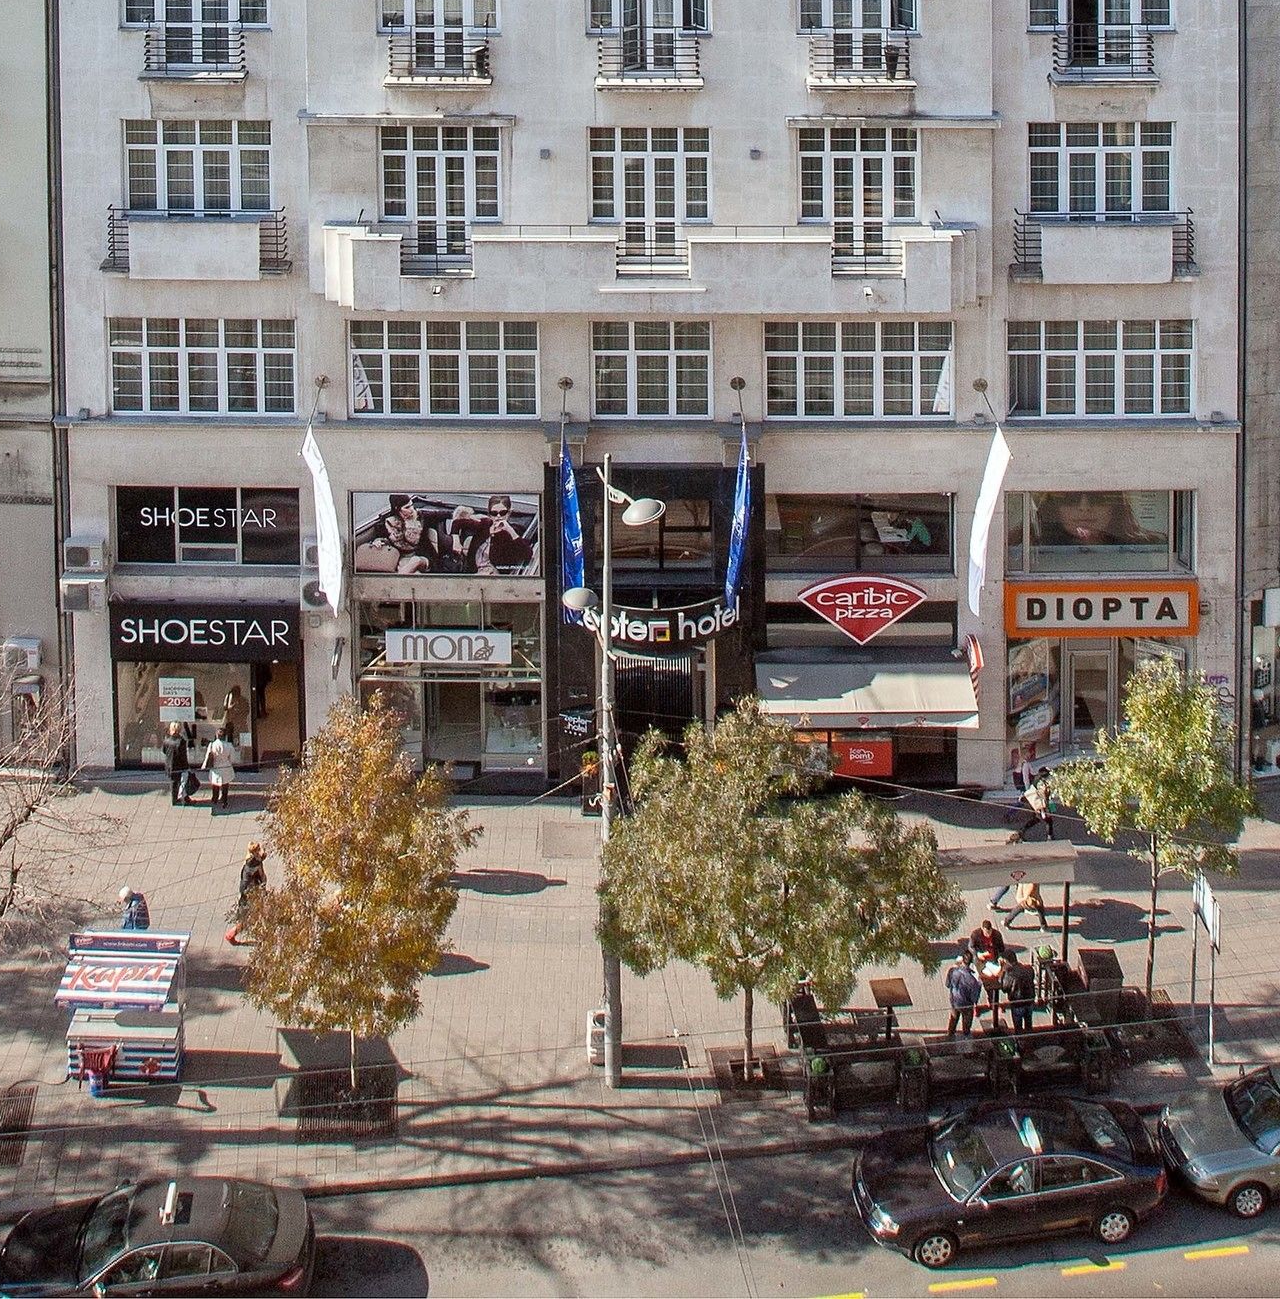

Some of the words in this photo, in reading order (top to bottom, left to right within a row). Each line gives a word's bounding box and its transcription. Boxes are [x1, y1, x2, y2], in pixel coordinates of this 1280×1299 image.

[816, 587, 909, 605] caribic
[678, 594, 740, 640] hotel
[835, 606, 893, 622] pizza
[1026, 597, 1178, 621] DIOPTA
[120, 618, 289, 646] SHOESTAR
[402, 634, 495, 661] mona
